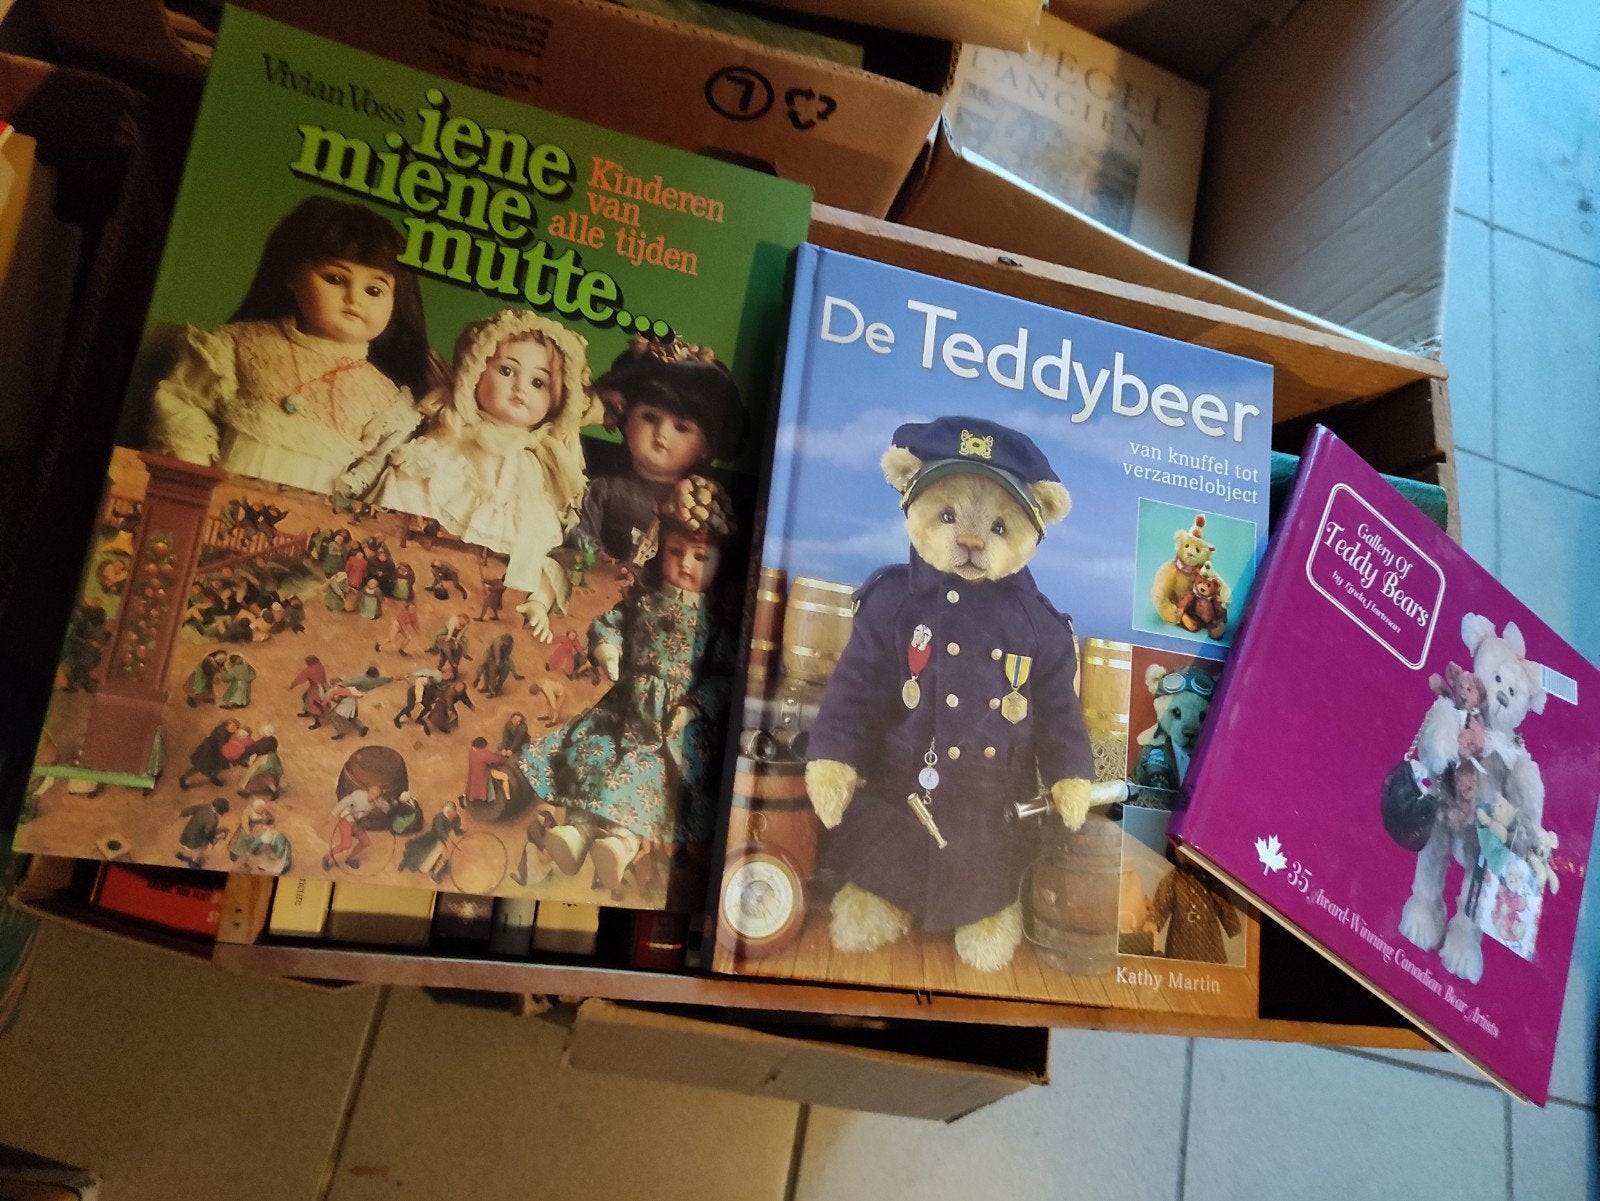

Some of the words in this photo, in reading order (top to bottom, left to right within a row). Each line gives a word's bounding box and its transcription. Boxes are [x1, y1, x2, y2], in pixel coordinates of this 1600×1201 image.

[263, 53, 345, 108] Vivian
[348, 82, 406, 126] Voss
[411, 88, 575, 198] iene
[290, 124, 536, 242] miene
[587, 191, 640, 227] van
[588, 156, 725, 224] Kinderen
[548, 211, 605, 249] alle
[616, 226, 698, 276] tijden
[820, 295, 895, 354] De
[907, 300, 1260, 442] Teddybeer
[1122, 462, 1258, 504] verzamelobject
[1129, 442, 1161, 460] van
[1168, 447, 1229, 476] knuffel
[1235, 465, 1259, 483] tot
[1324, 521, 1379, 589] Teddy
[1380, 571, 1429, 627] Bears
[1357, 523, 1395, 567] Gallery
[1395, 556, 1413, 580] Of
[1332, 570, 1344, 586] by
[1345, 582, 1367, 605] Linda
[1363, 600, 1401, 634] Hartman
[1116, 966, 1162, 991] Kathy
[1168, 971, 1220, 992] Martin
[1287, 861, 1312, 893] 35
[1395, 948, 1442, 997] Canadian
[1444, 985, 1469, 1013] Bear
[1463, 1006, 1500, 1038] Artists
